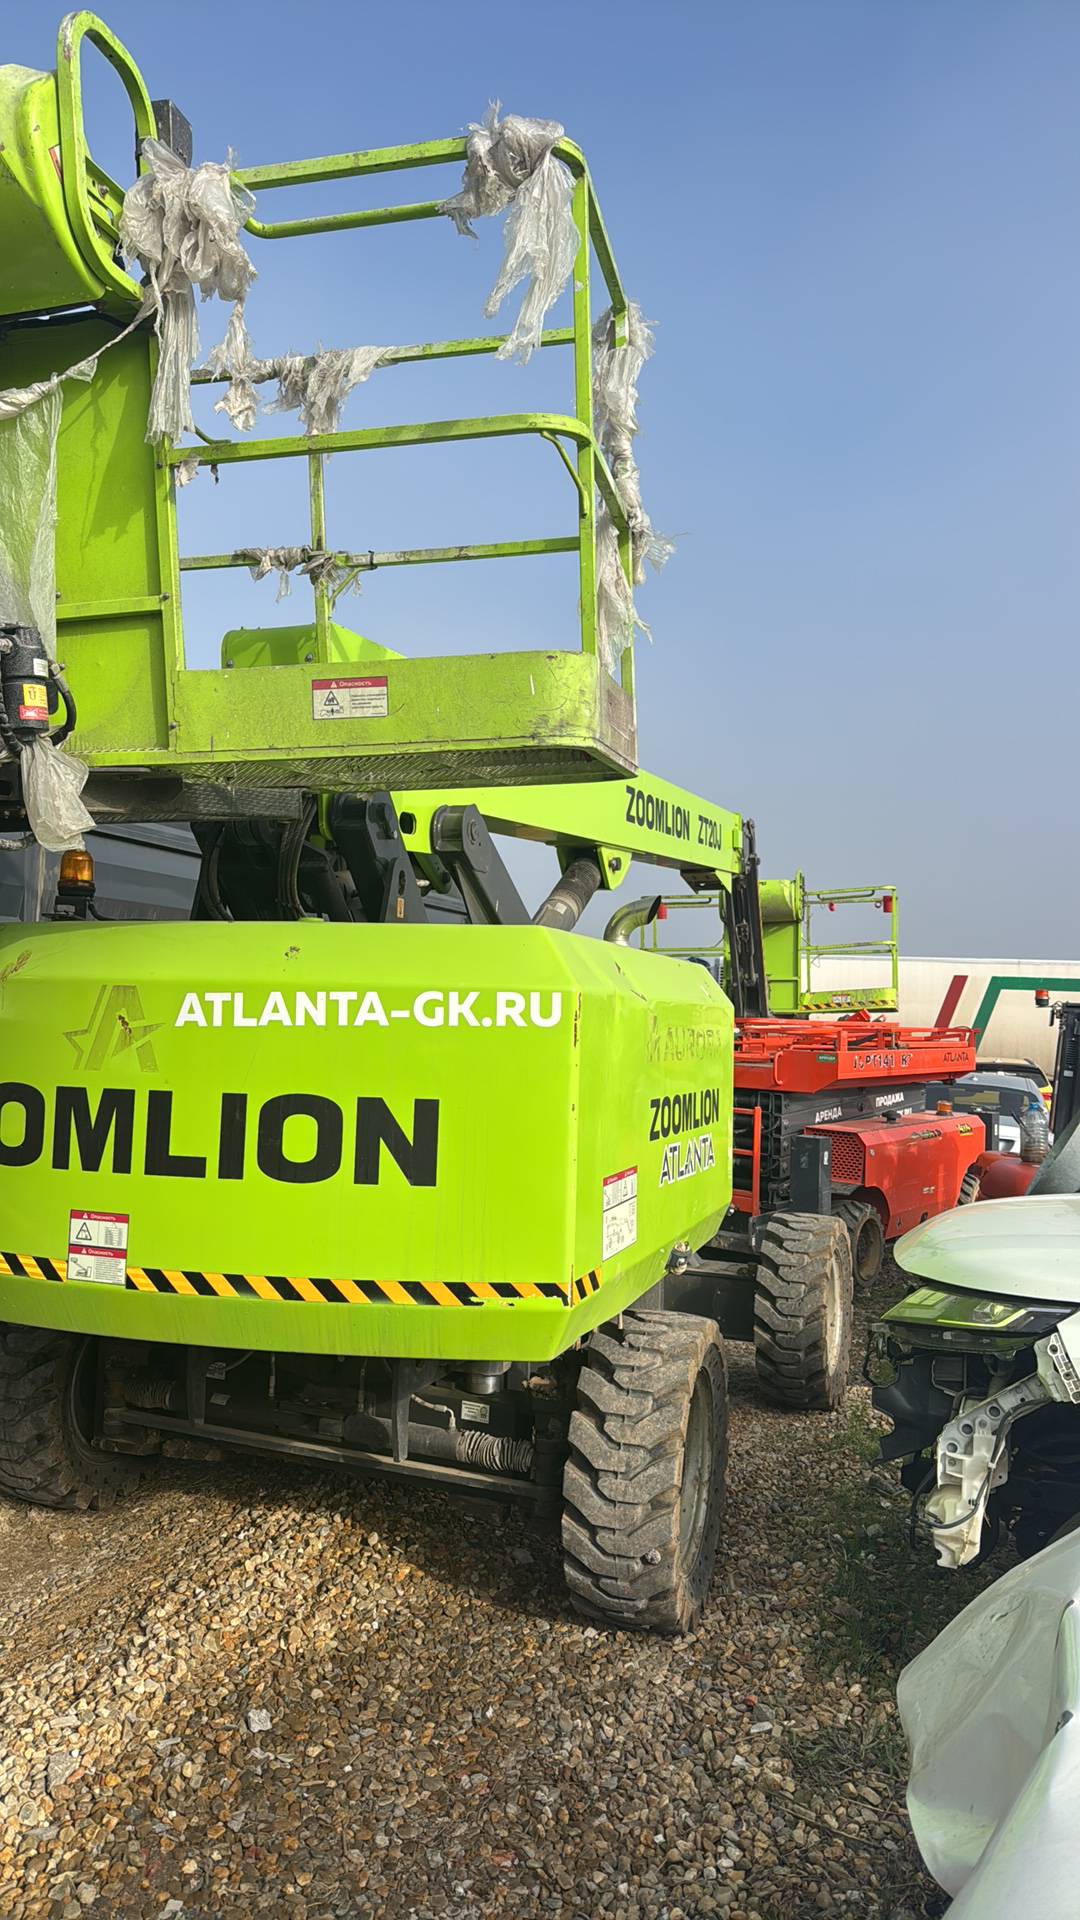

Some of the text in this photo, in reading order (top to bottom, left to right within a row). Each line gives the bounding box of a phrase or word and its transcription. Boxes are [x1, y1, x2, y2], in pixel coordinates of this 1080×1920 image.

[626, 785, 722, 851] ZOOMLION ZT20J
[175, 990, 563, 1027] ATLANTA-GK.RU
[943, 1051, 969, 1062] ATLANTA
[650, 1088, 720, 1141] ZOOMLION
[815, 1106, 843, 1123] АРЕНДА
[875, 1092, 905, 1108] ПРОДАЖА
[660, 1133, 716, 1187] ATLANTA
